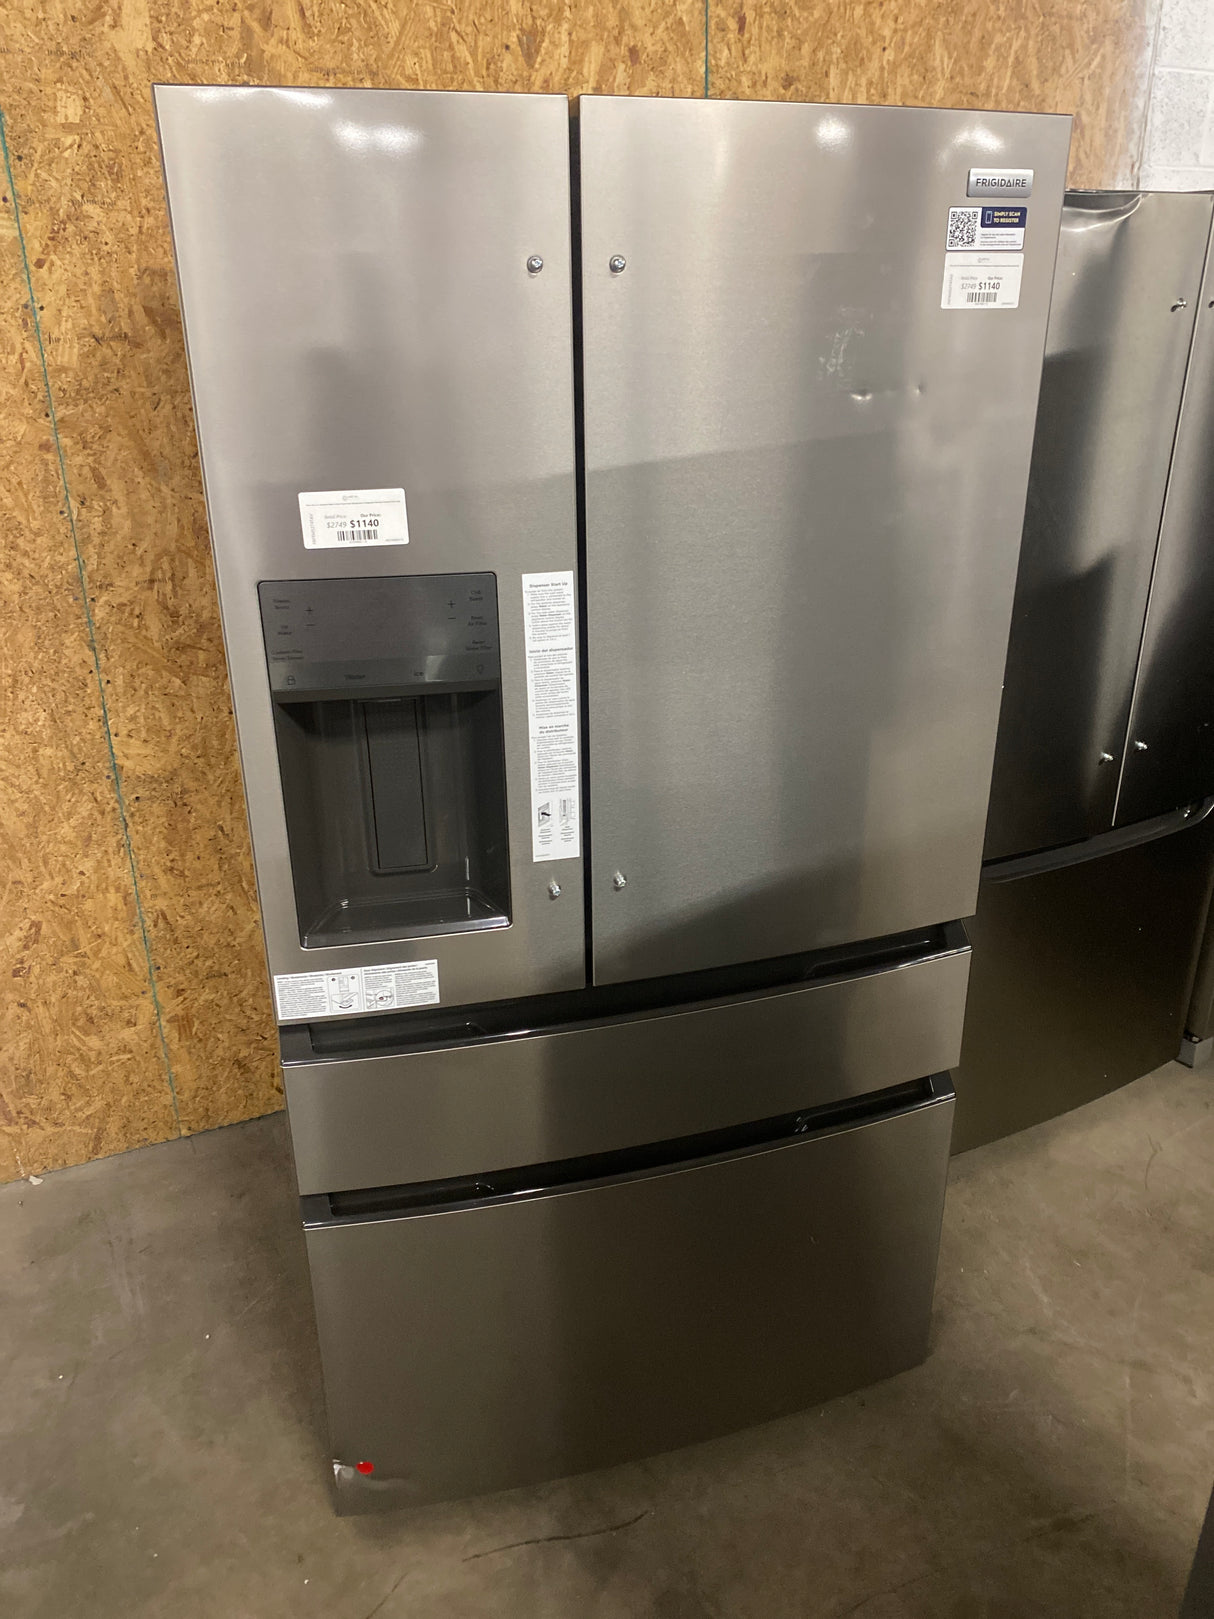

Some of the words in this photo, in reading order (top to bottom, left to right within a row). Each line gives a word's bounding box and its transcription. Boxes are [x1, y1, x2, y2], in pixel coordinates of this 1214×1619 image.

[975, 178, 1027, 187] FRIGIDAIRE
[978, 282, 1001, 290] $1140
[326, 521, 347, 529] $2749
[350, 518, 379, 528] $1140
